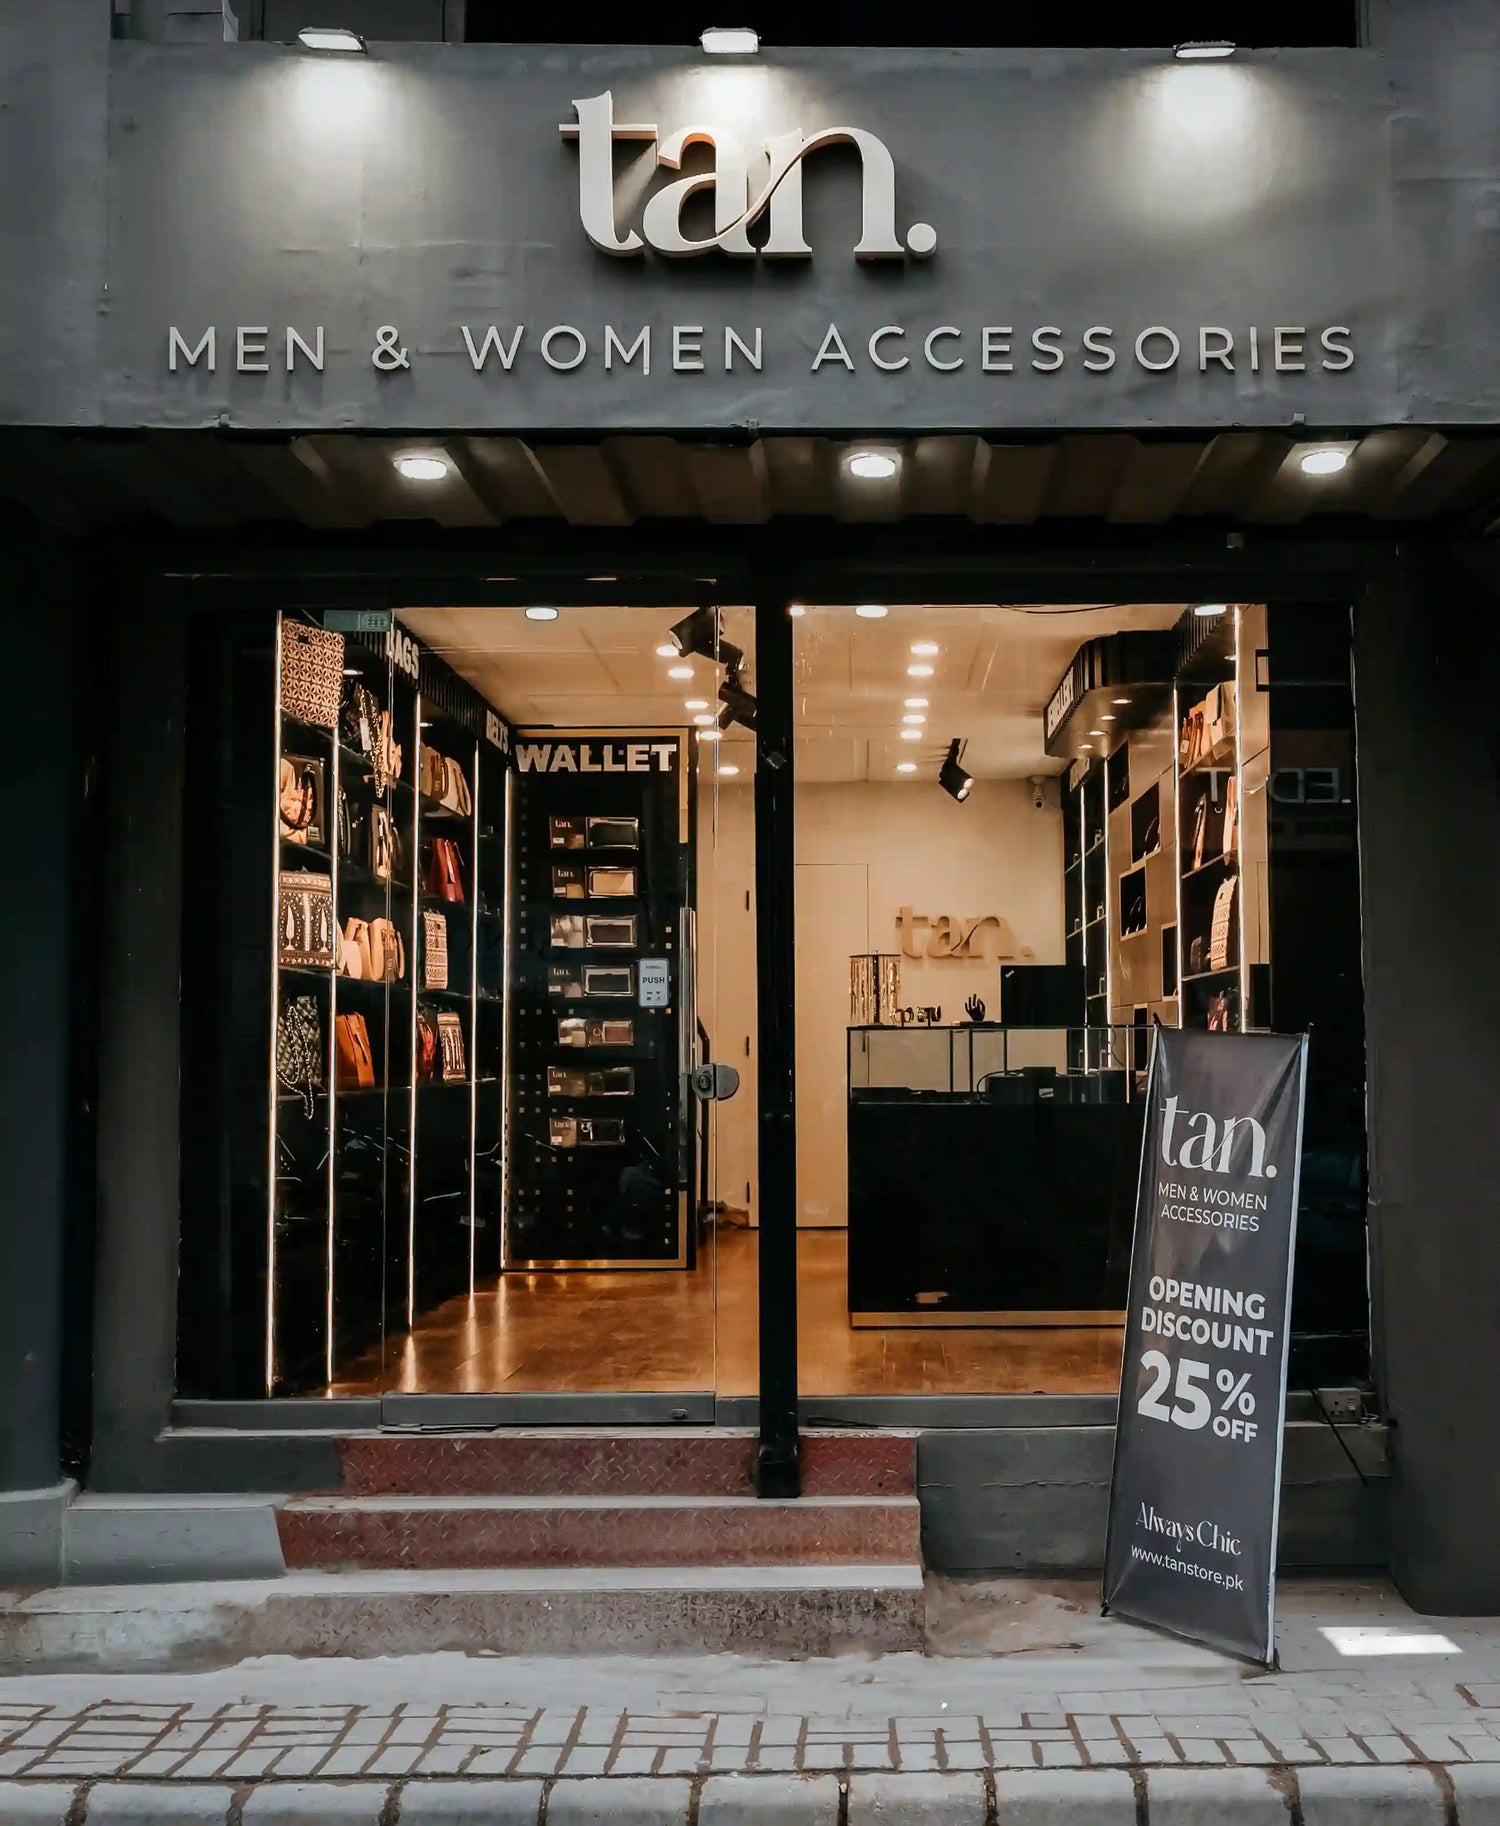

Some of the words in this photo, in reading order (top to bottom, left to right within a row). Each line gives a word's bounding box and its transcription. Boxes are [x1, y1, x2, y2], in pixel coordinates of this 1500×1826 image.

[559, 89, 938, 258] tan.
[168, 326, 324, 371] MEN
[372, 325, 410, 370] &
[461, 325, 762, 375] WOMEN
[811, 322, 1355, 371] ACCESSORIES
[515, 744, 678, 773] WALLET
[895, 905, 1035, 962] tan.
[642, 976, 665, 984] PUSH
[1159, 1095, 1278, 1178] tan.
[1158, 1182, 1187, 1200] MEN
[1189, 1186, 1199, 1202] &
[1203, 1187, 1267, 1211] WOMEN
[1161, 1203, 1260, 1232] ACCESSORIES
[1149, 1275, 1266, 1320] OPENING
[1141, 1306, 1274, 1357] DISCOUNT
[1212, 1416, 1258, 1443] OFF
[1135, 1502, 1194, 1553] Always
[1196, 1520, 1241, 1556] Chic
[1131, 1545, 1244, 1592] www.tanstore.pk
